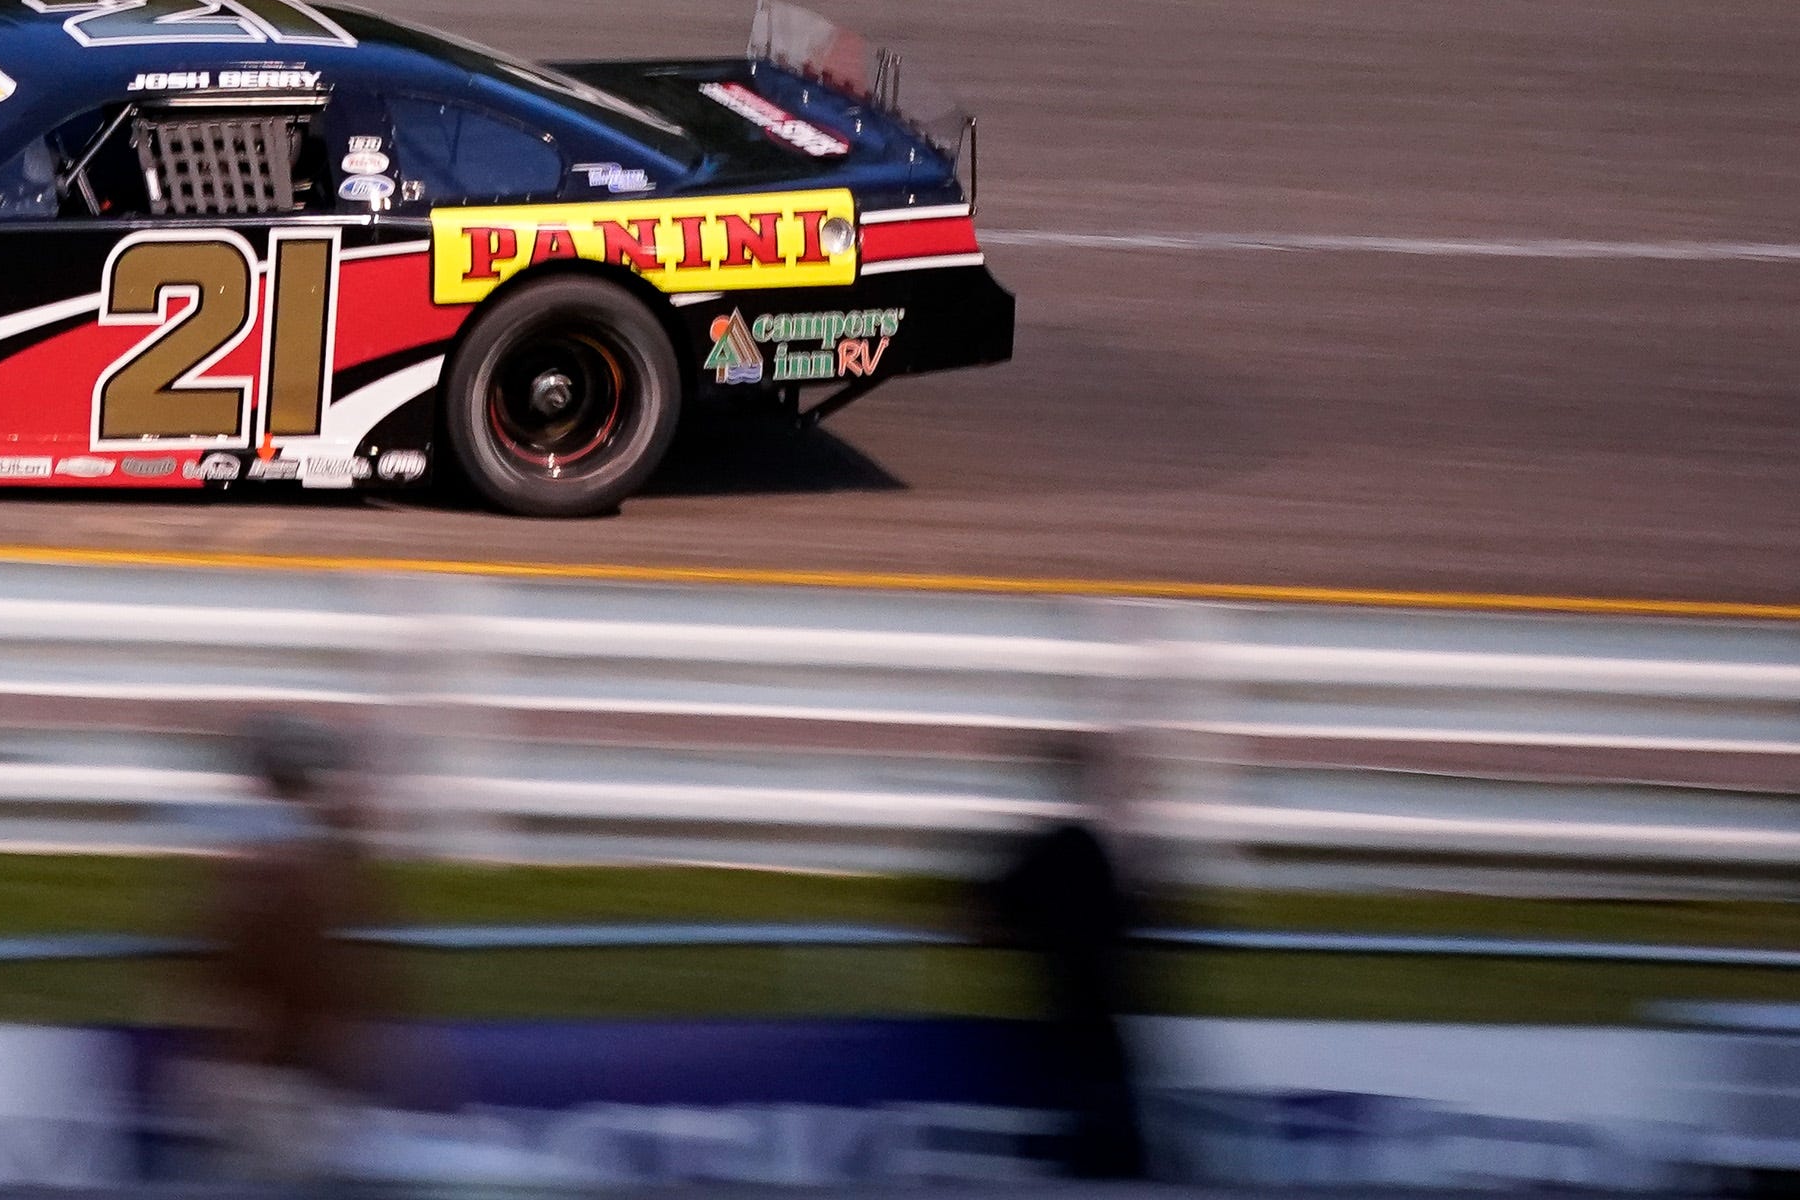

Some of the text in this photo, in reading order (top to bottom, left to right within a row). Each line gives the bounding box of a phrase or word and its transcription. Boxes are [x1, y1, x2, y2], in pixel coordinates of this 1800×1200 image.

[127, 71, 322, 91] JOSH BERRY
[462, 210, 829, 280] PANINI
[89, 226, 342, 452] 21
[773, 337, 890, 381] inn RV
